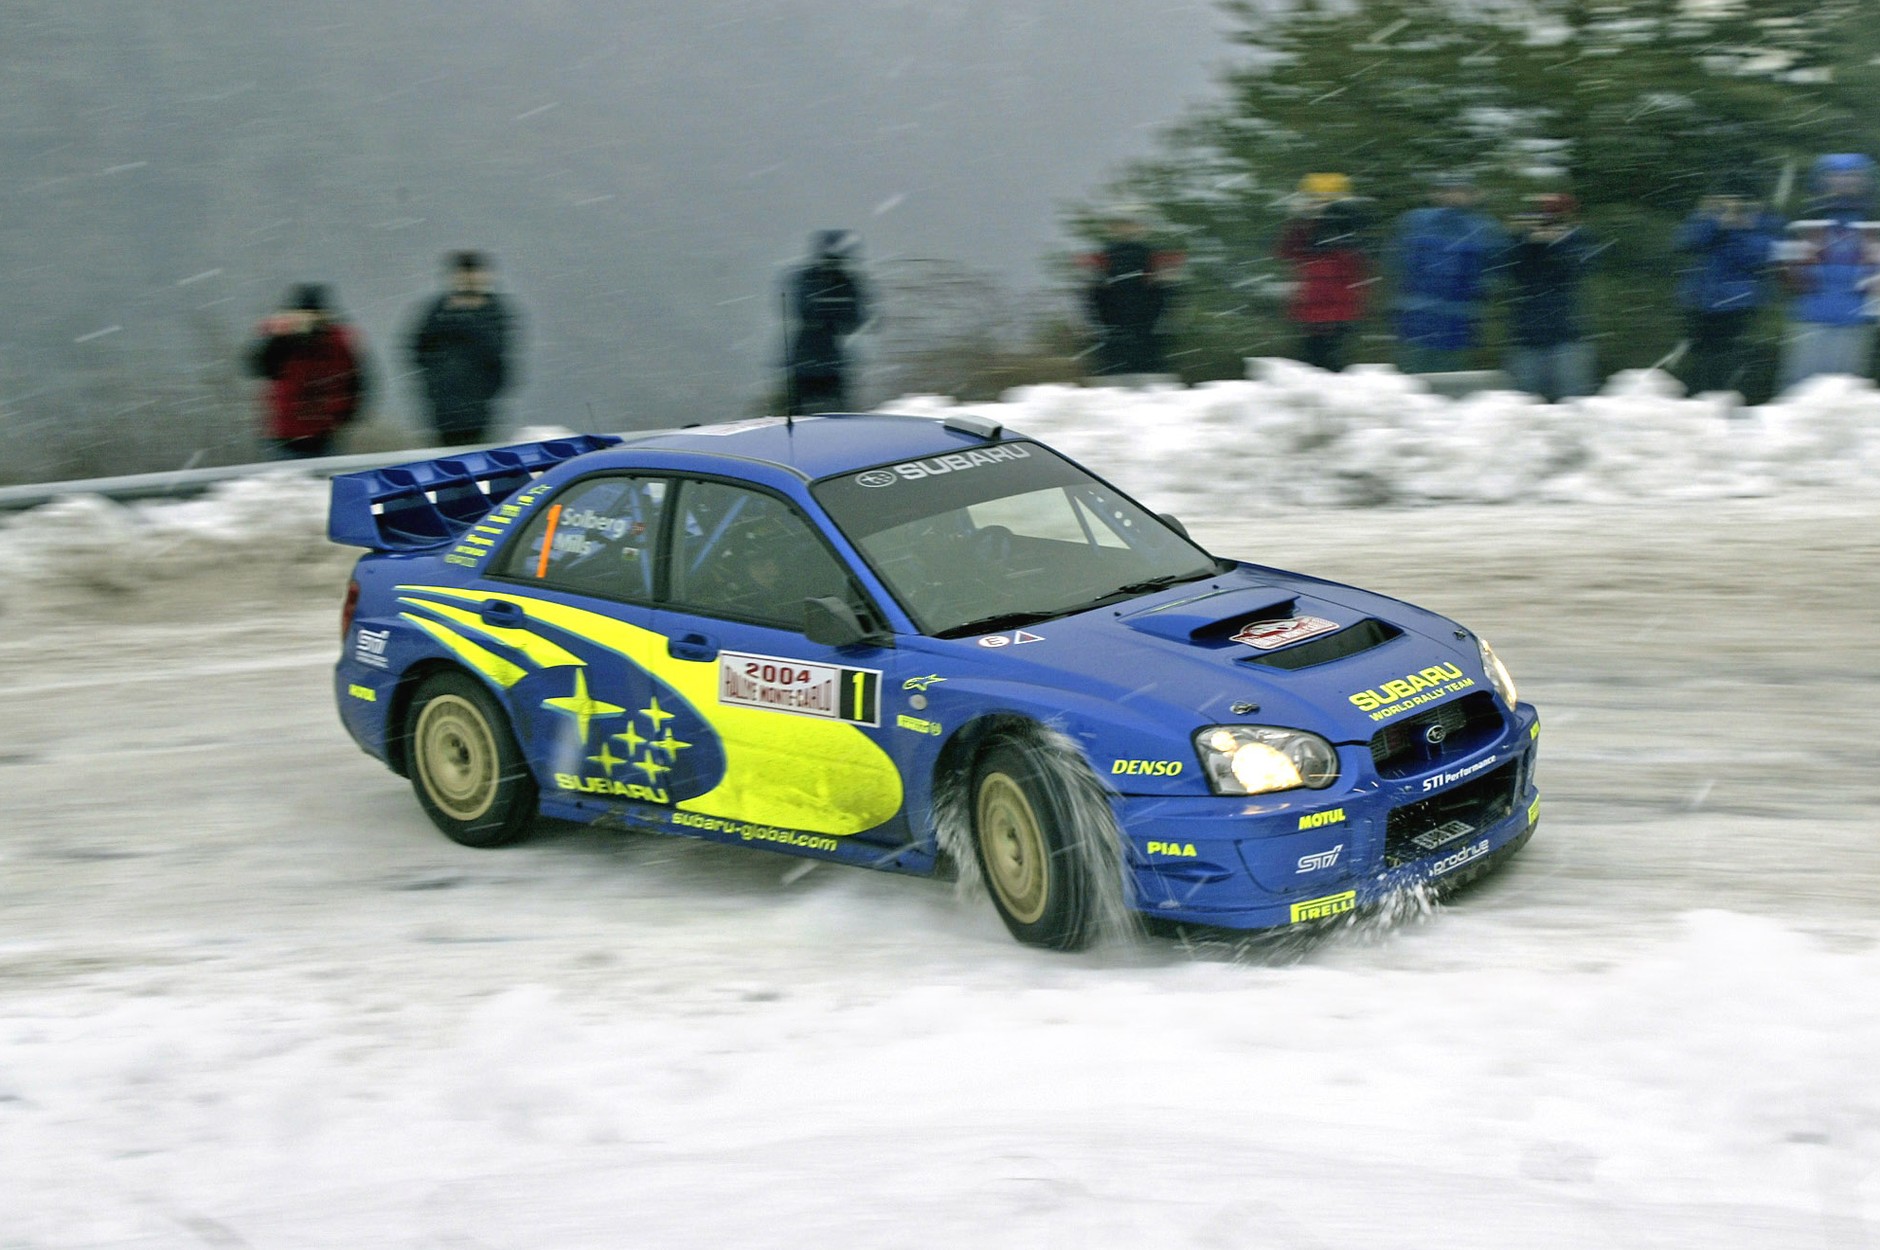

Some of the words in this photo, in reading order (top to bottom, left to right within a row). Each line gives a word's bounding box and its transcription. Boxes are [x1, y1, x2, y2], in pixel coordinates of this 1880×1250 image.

[894, 444, 1031, 480] SUBARU
[536, 504, 562, 578] 1
[560, 508, 625, 539] Solberg
[745, 662, 812, 685] 2004
[1349, 662, 1463, 712] SUBARU
[852, 672, 865, 720] 1
[1369, 701, 1414, 721] WORLD
[1415, 688, 1446, 706] RALLY
[1445, 678, 1475, 697] TEAM
[1111, 759, 1183, 777] DENSO
[1422, 774, 1443, 792] STI
[1445, 755, 1497, 784] Performance
[554, 773, 669, 804] SUBARU
[671, 811, 837, 852] subaru-global.com
[1298, 808, 1345, 830] MOTUL
[1147, 841, 1197, 857] PIAA
[1433, 839, 1489, 876] prodrive
[1289, 890, 1356, 924] PIRELLI
